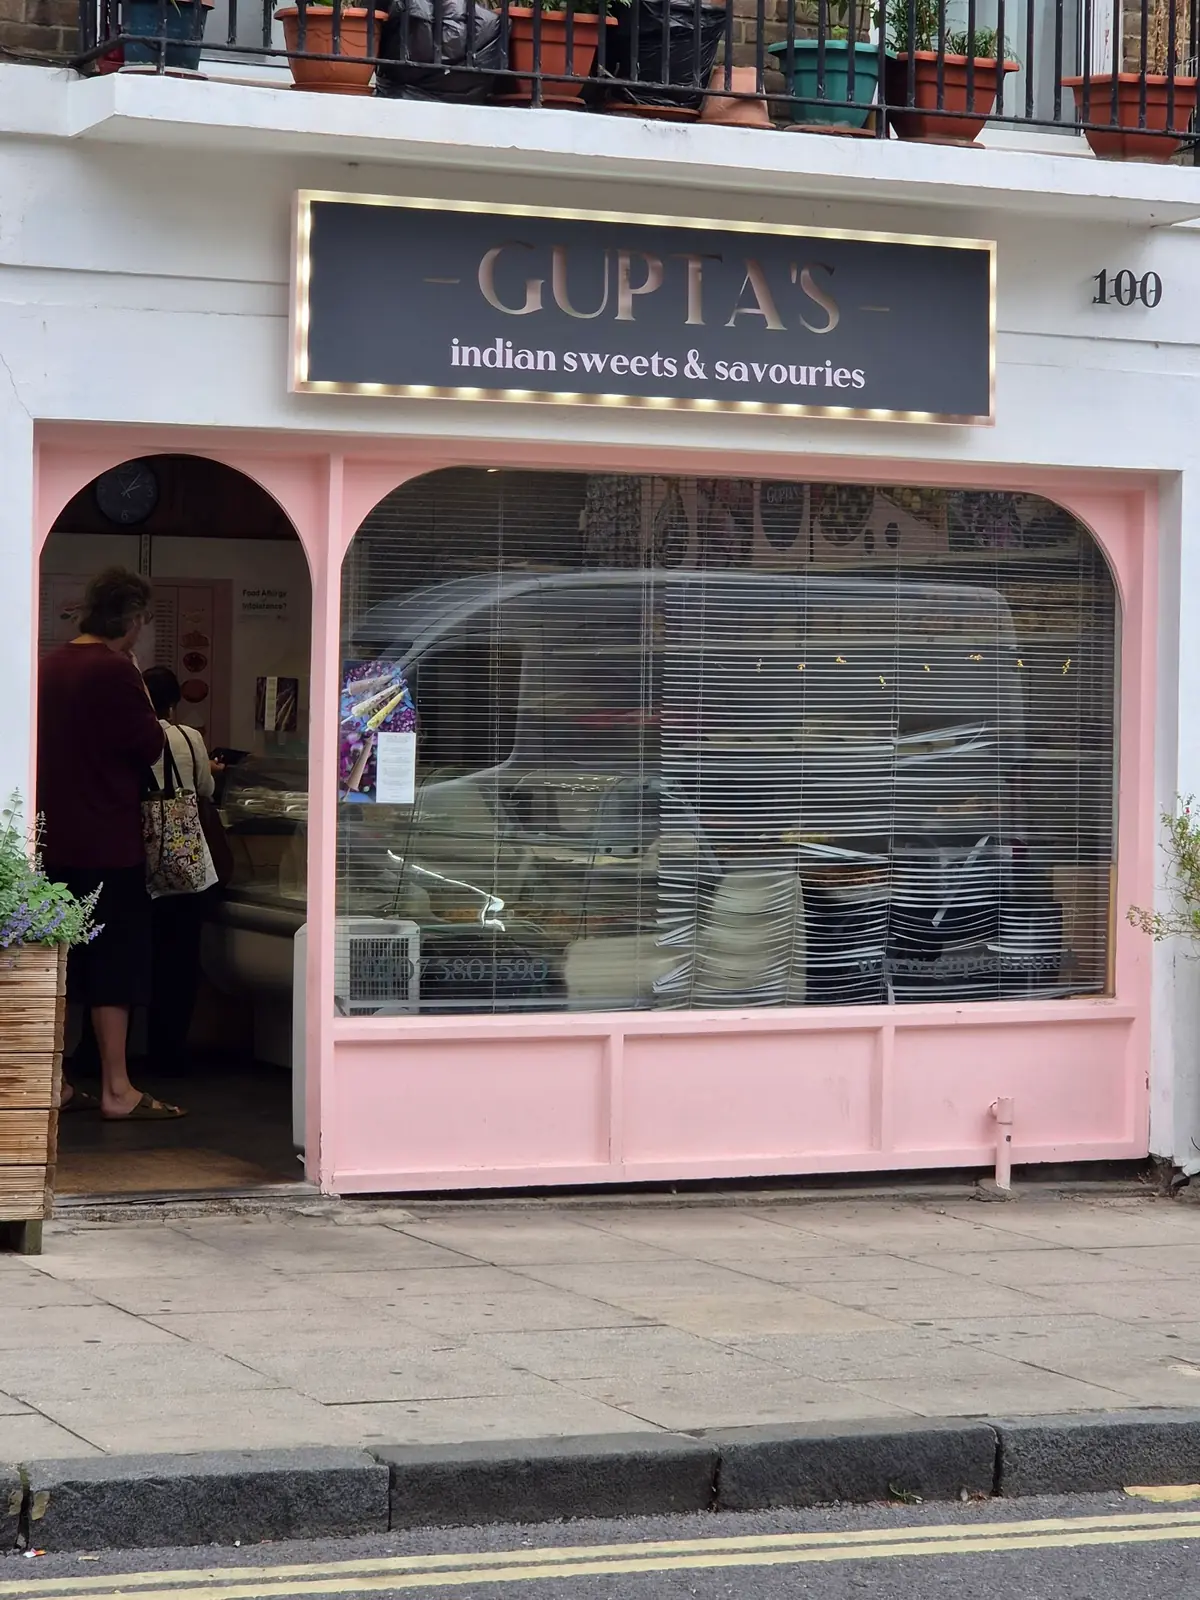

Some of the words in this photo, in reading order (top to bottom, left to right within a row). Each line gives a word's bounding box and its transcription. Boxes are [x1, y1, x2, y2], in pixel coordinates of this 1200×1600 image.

[478, 239, 840, 334] GUPTA'S
[1092, 268, 1163, 308] 100
[451, 337, 557, 372] indian
[563, 349, 678, 379] sweets
[684, 348, 709, 380] &
[714, 359, 866, 389] savouries
[435, 958, 485, 982] 380
